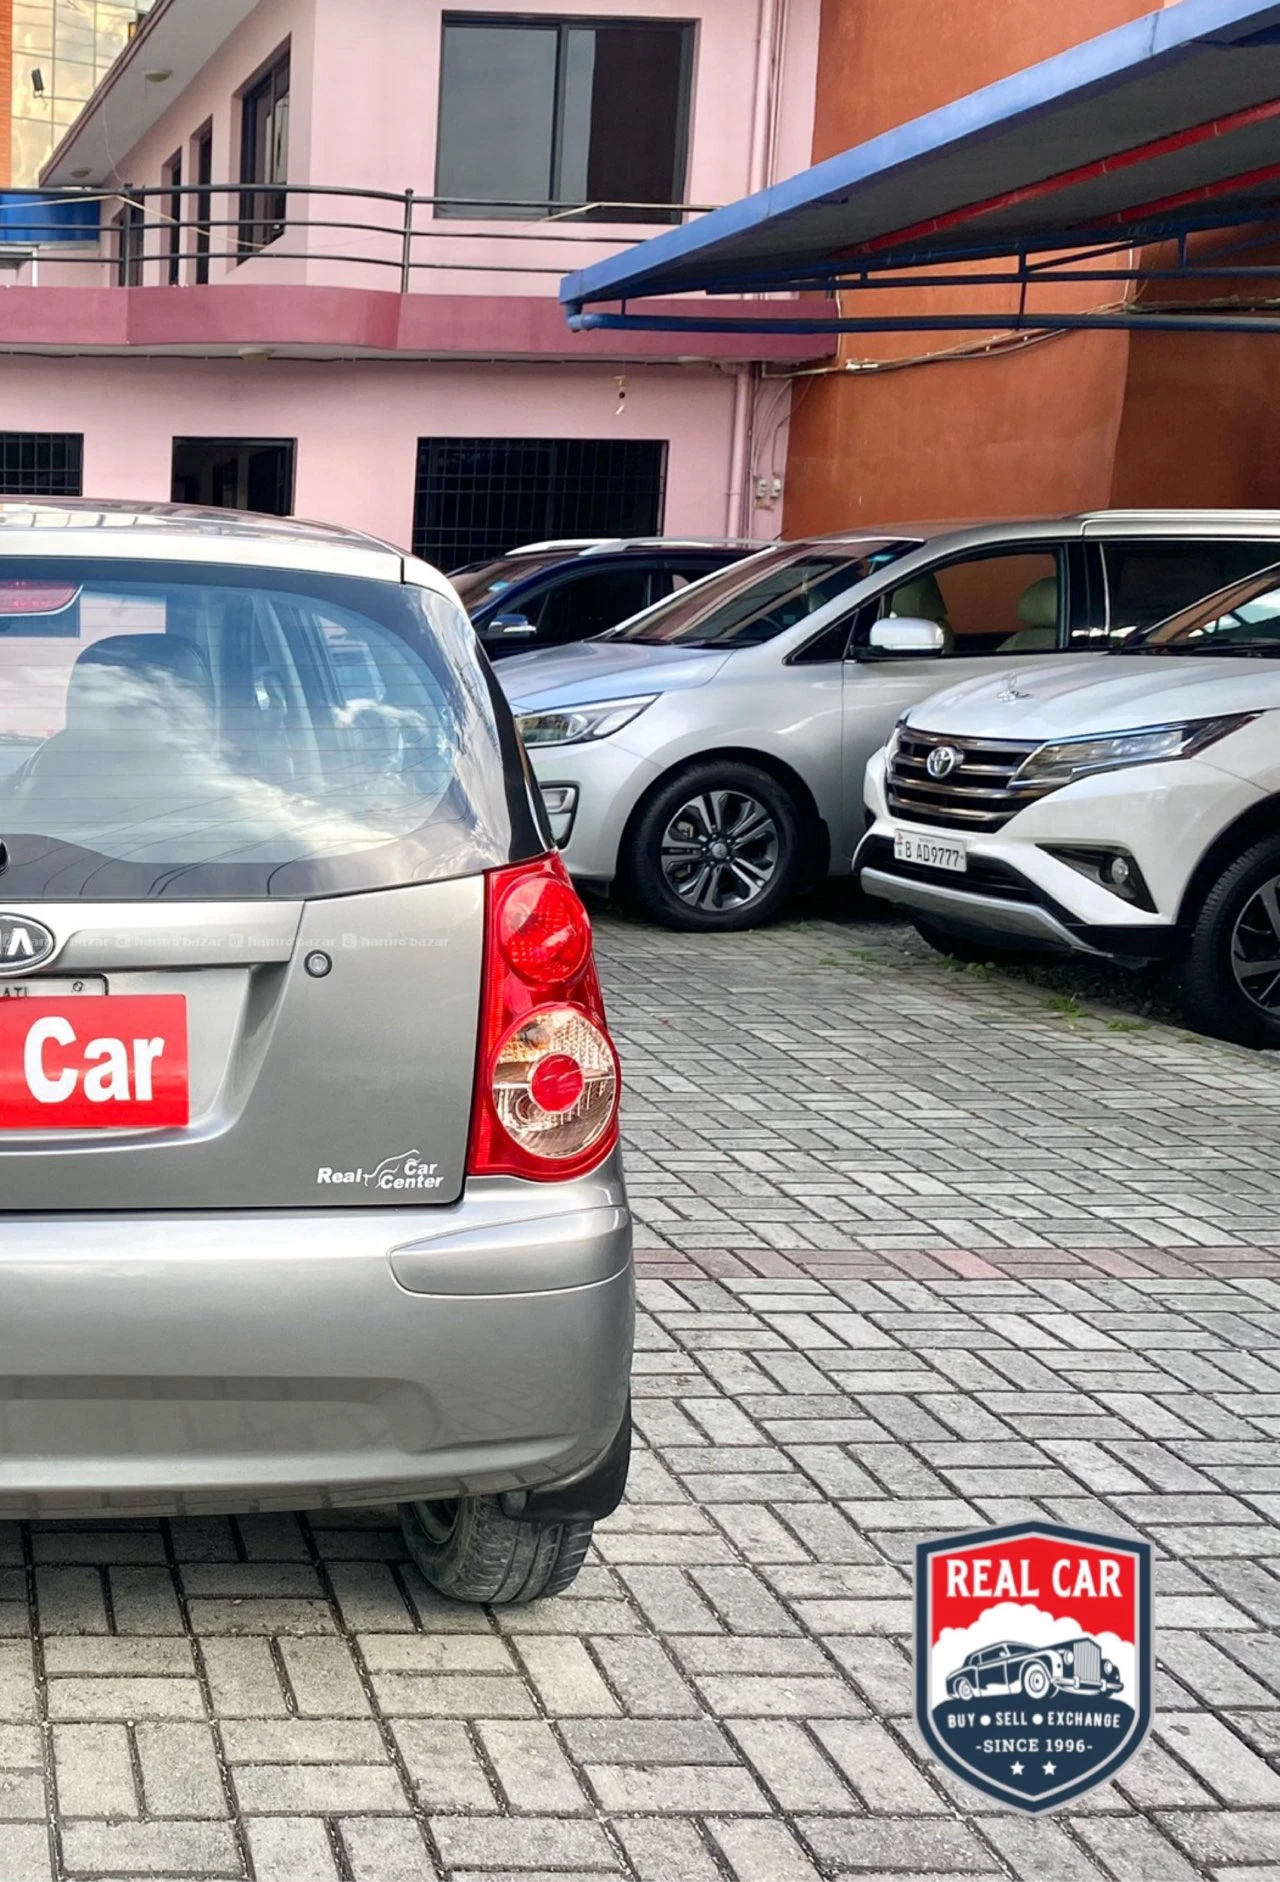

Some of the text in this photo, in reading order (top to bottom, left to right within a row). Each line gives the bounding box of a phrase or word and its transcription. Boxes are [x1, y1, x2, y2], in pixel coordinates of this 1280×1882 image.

[905, 841, 912, 858] B
[24, 1016, 166, 1104] Car
[317, 1167, 363, 1184] Real
[404, 1159, 438, 1176] Car
[379, 1174, 445, 1189] Center
